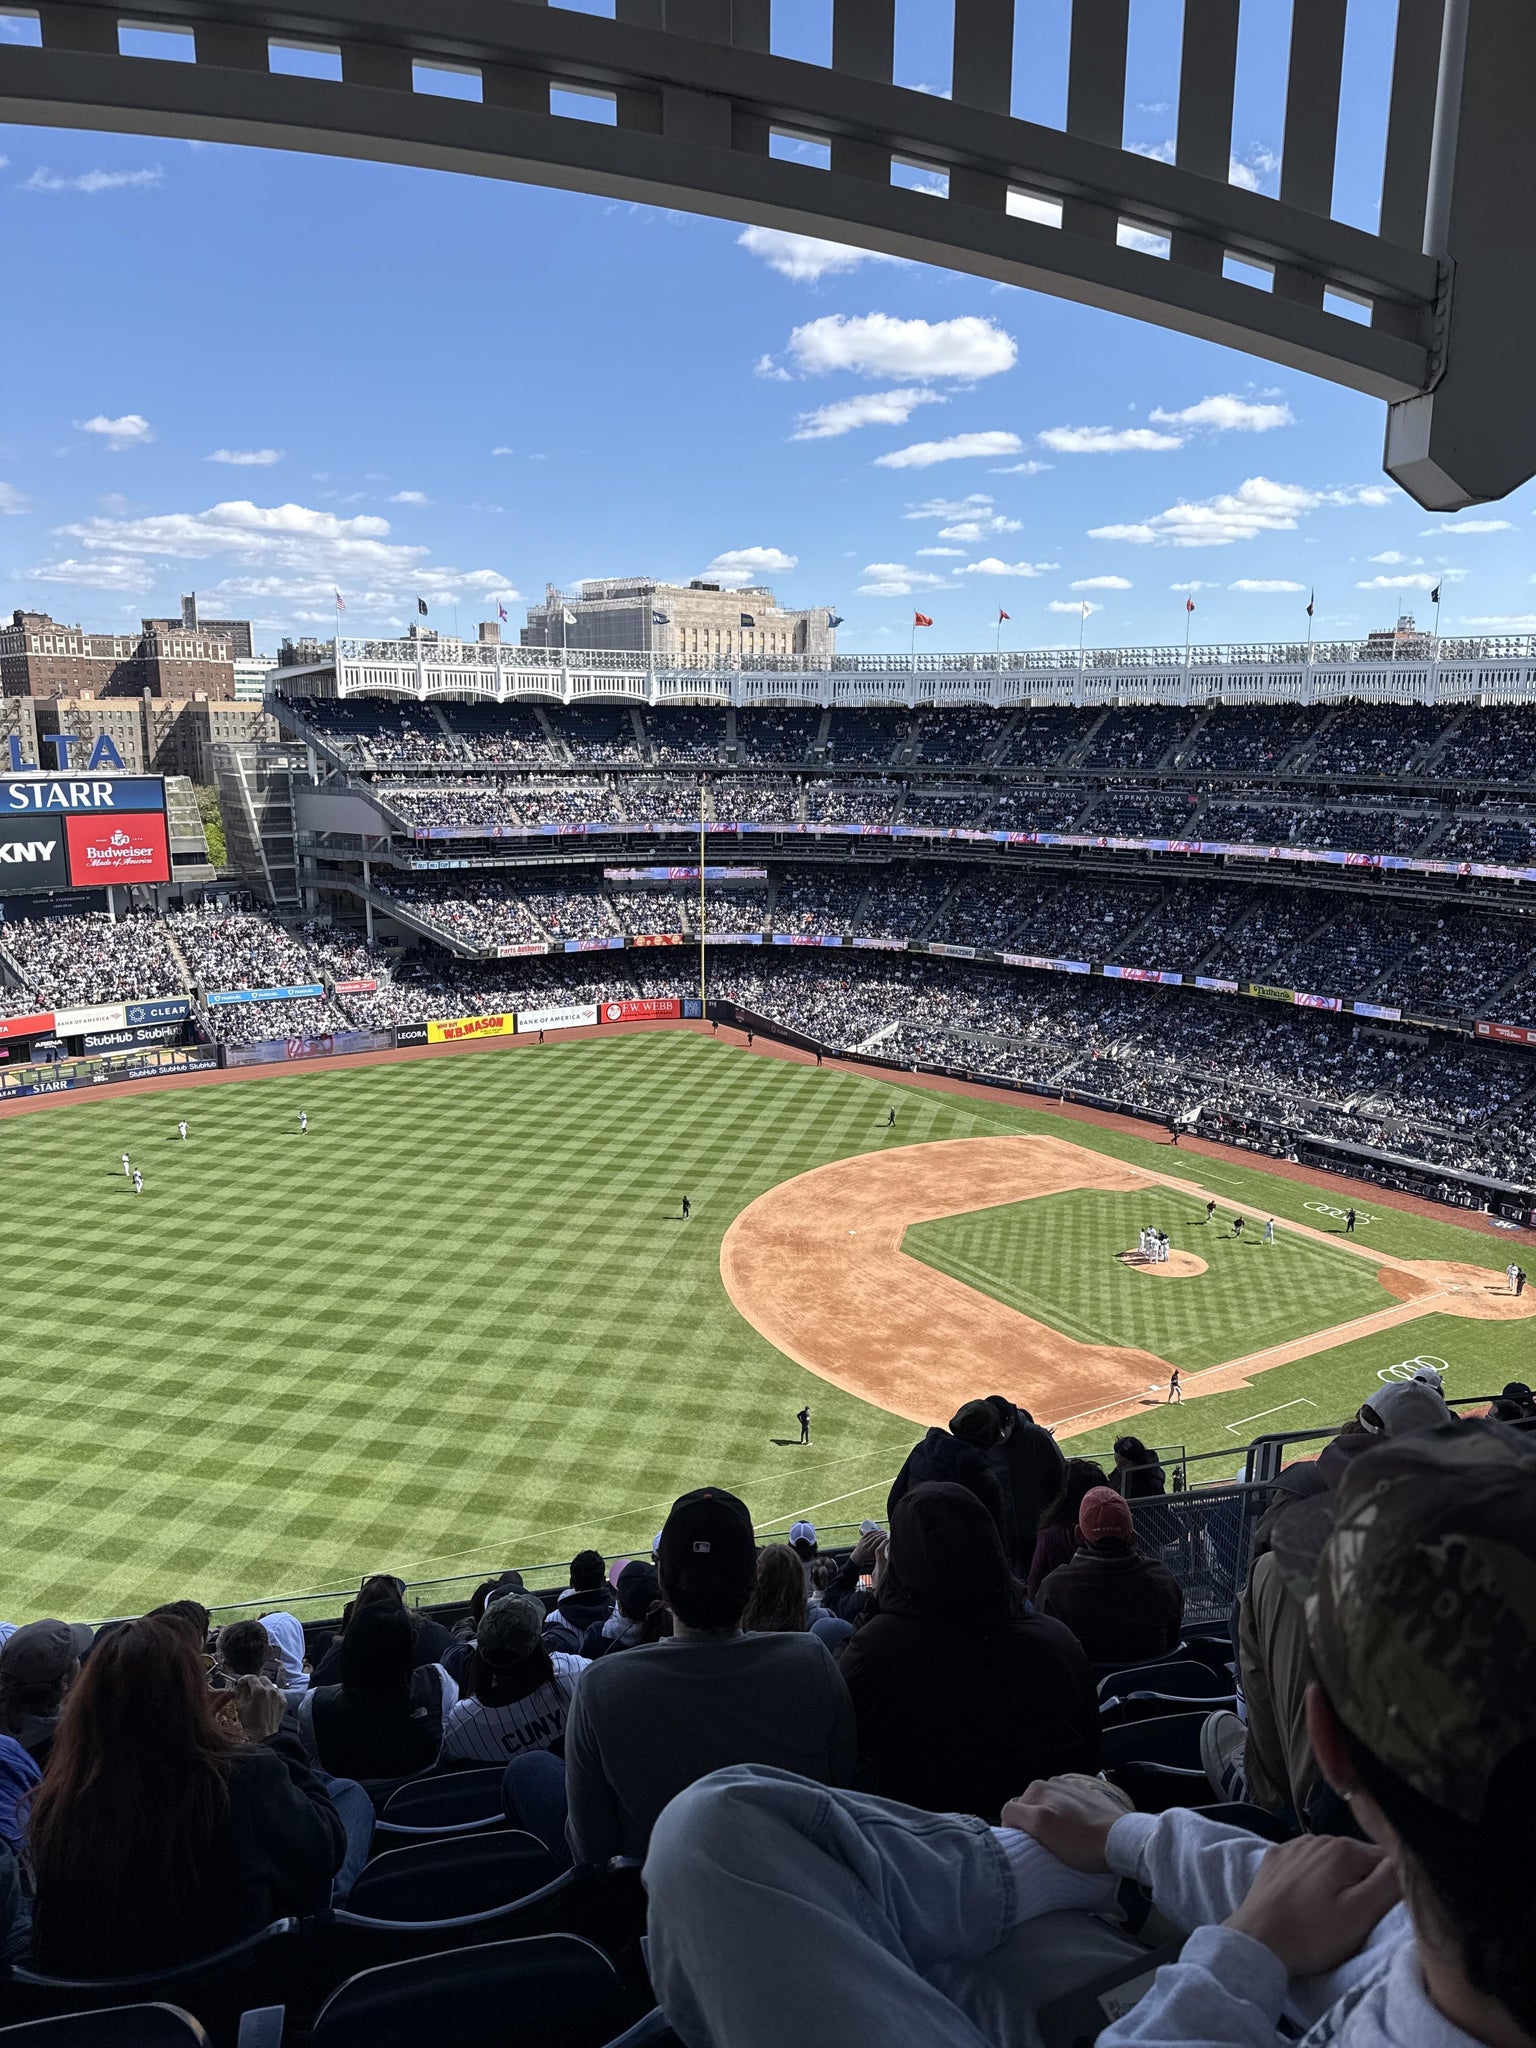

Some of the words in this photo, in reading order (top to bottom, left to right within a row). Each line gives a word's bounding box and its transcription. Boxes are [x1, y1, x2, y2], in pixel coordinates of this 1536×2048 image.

[8, 735, 125, 772] LTA
[9, 781, 115, 809] STARR
[1013, 790, 1040, 798] ASPEN
[1112, 793, 1142, 801] ASPEN
[1152, 795, 1182, 803] VODKA
[86, 846, 154, 859] Budweiser
[86, 858, 111, 867] Made
[112, 858, 121, 867] of
[120, 857, 153, 865] America
[500, 947, 517, 955] Parts
[517, 944, 546, 954] Authority
[336, 983, 361, 991] Reebok
[1253, 985, 1292, 999] Nathan's
[150, 1006, 186, 1017] CLEAR
[643, 1001, 673, 1011] WEBB
[550, 1014, 581, 1022] AMERICA
[85, 1032, 133, 1047] StubHub
[137, 1023, 183, 1040] StubHub
[397, 1030, 427, 1040] LEGORA
[35, 1039, 63, 1048] ARENA
[128, 1068, 157, 1078] StubHub
[158, 1065, 187, 1074] StubHub
[189, 1061, 217, 1070] StubHub
[33, 1080, 68, 1093] STARR
[501, 1708, 562, 1754] CUNY
